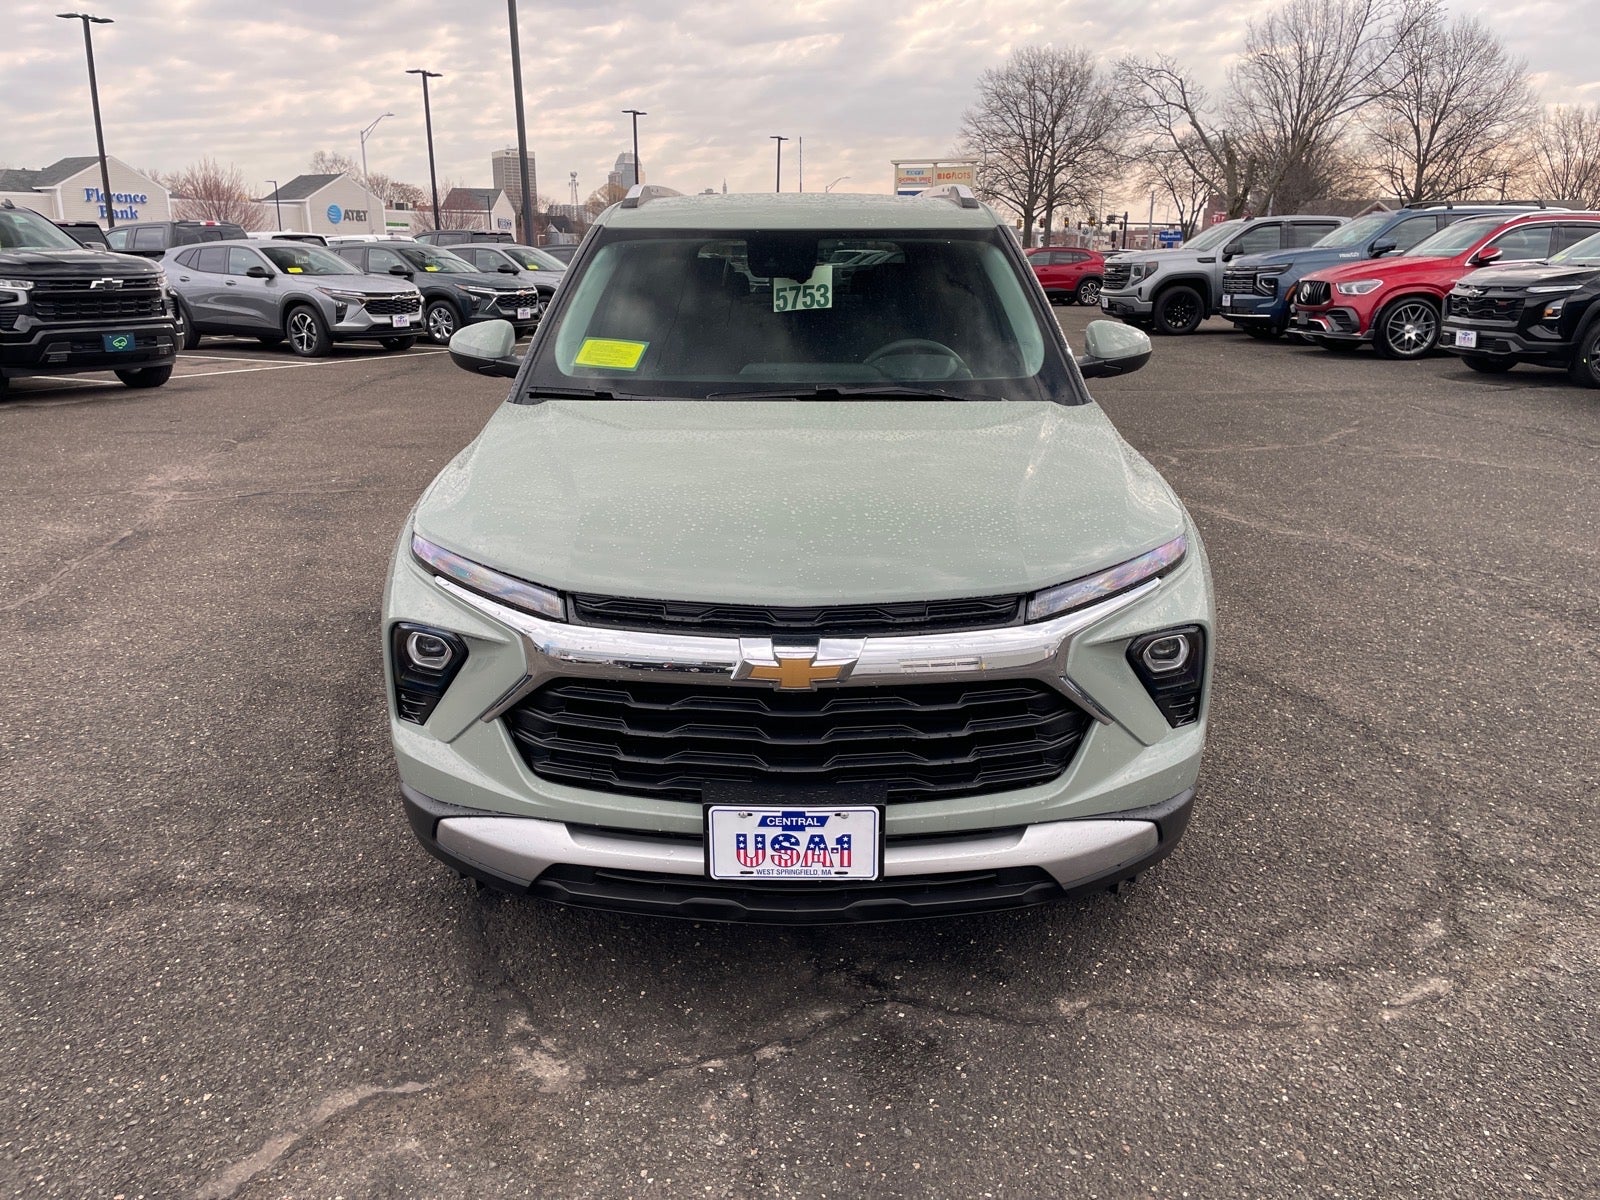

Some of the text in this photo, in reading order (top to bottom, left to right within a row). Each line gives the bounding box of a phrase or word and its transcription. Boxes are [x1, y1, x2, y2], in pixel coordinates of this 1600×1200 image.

[84, 187, 148, 204] Florence
[98, 205, 138, 219] Bank
[343, 209, 368, 221] AT&T
[775, 283, 829, 311] 5753
[766, 817, 820, 826] CENTRAL
[735, 833, 852, 868] USA-1
